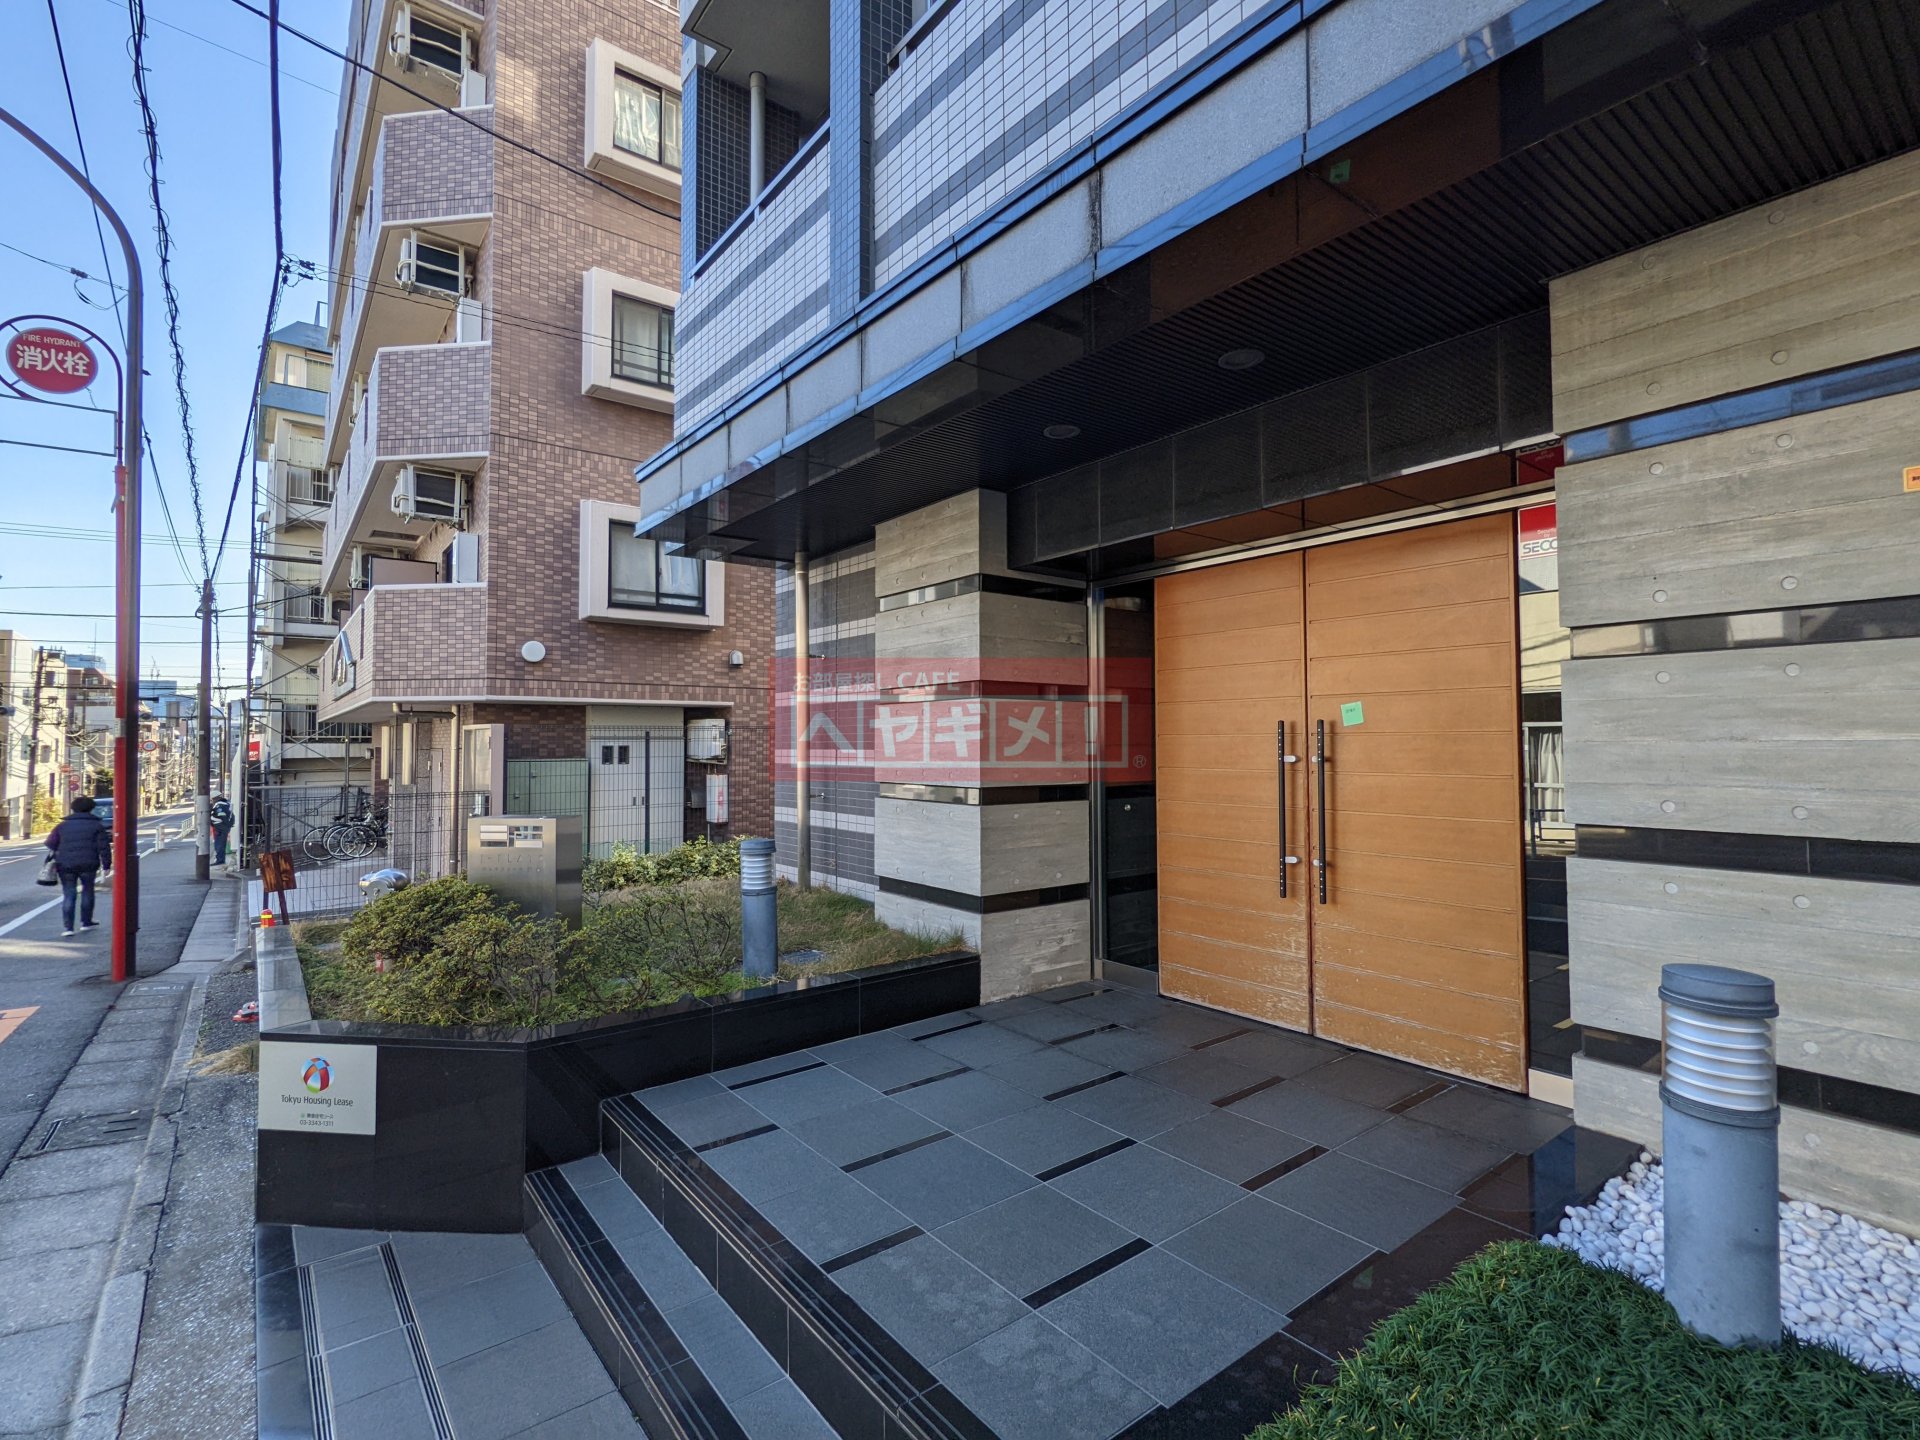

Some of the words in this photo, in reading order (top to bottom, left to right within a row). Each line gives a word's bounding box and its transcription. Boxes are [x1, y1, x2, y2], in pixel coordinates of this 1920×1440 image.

[22, 333, 42, 343] FIRE
[43, 336, 82, 348] HYDRANT
[16, 343, 90, 377] 消火栓
[281, 1094, 302, 1106] Tokyu
[303, 1095, 332, 1107] Housing
[333, 1097, 354, 1107] Lease
